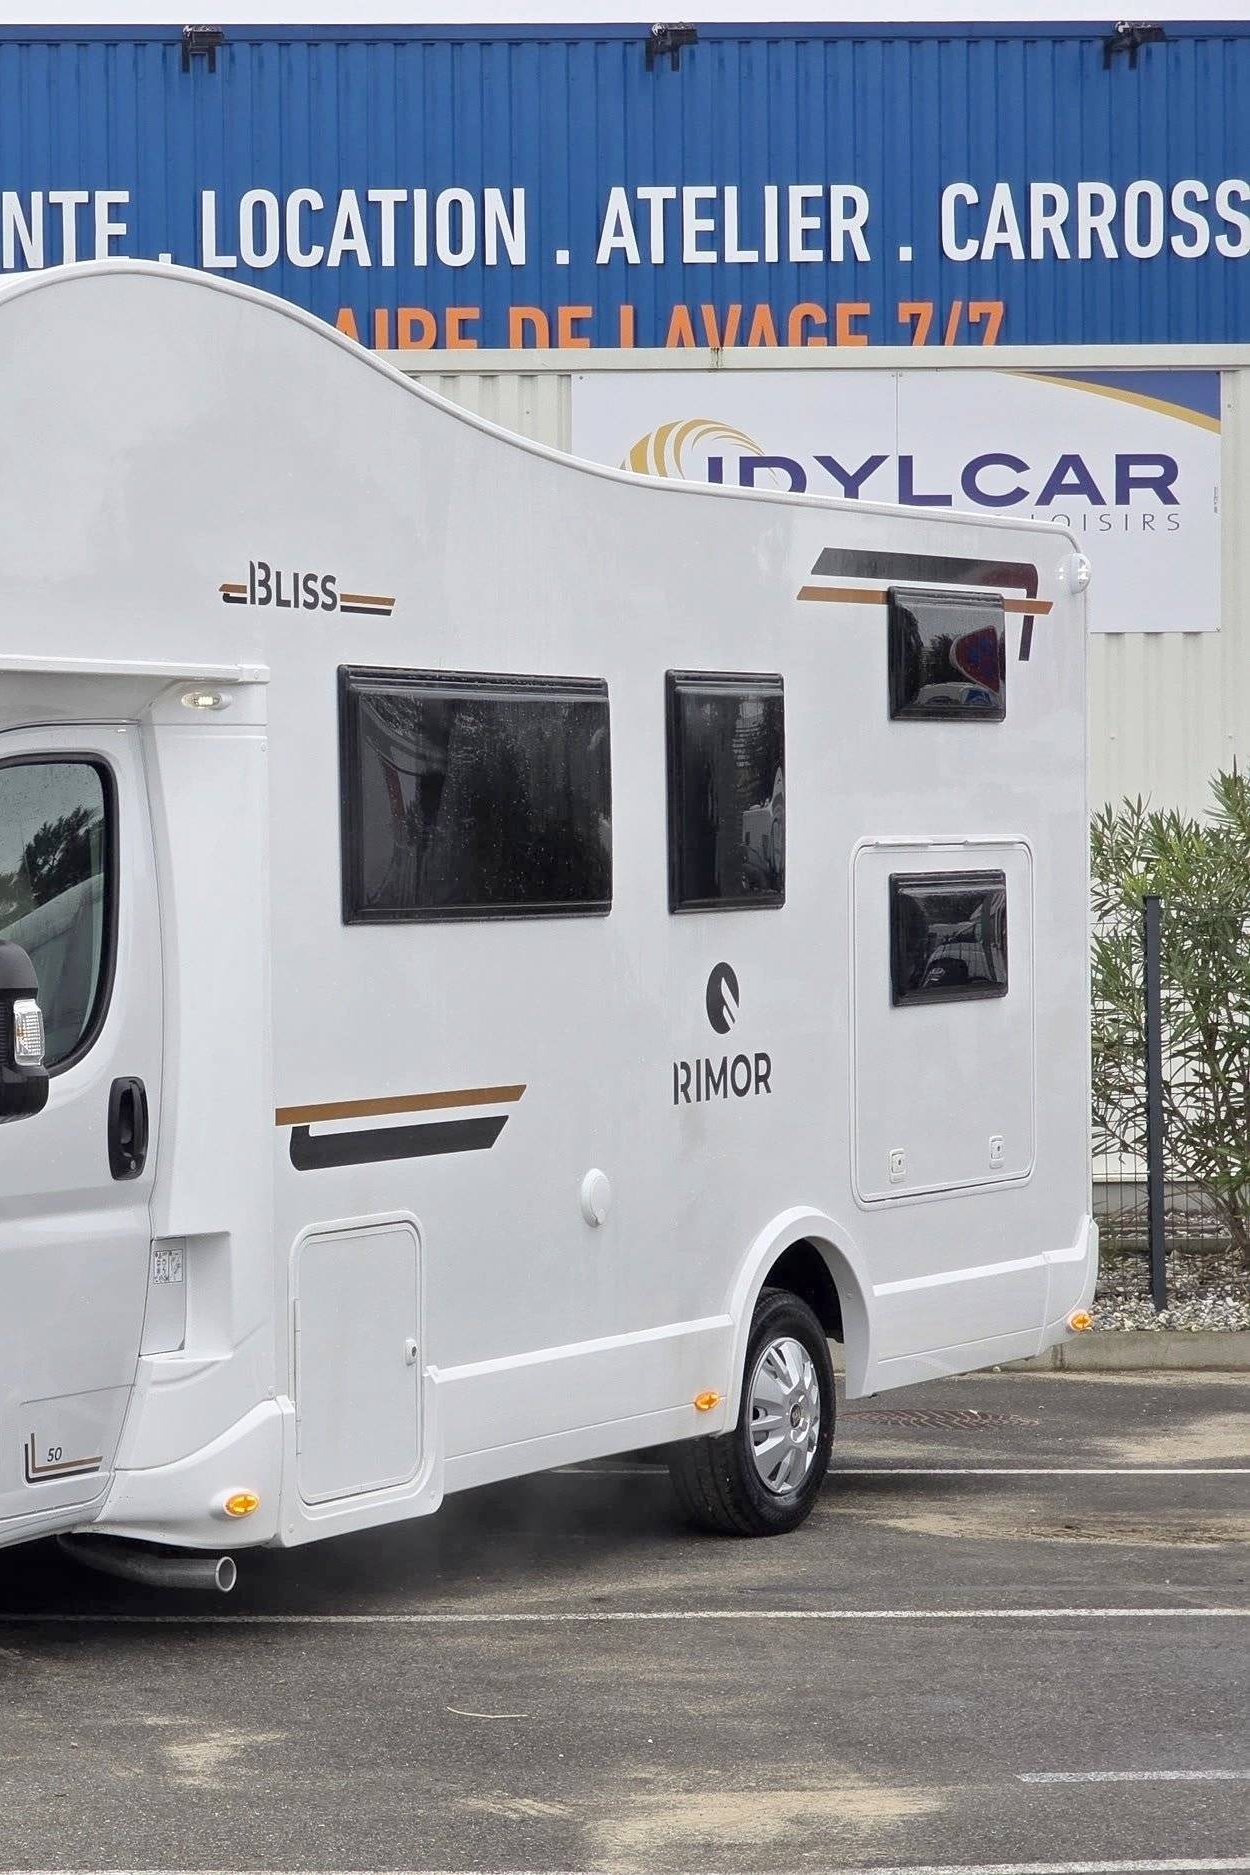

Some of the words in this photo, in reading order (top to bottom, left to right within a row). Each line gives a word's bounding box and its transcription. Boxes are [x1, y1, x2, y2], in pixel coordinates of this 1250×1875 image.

[202, 187, 526, 268] LOCATION
[596, 184, 872, 265] ATELIER
[941, 178, 1250, 262] CARROSS
[509, 305, 593, 349] DE
[898, 300, 1005, 348] 7/7
[707, 453, 1181, 507] IDYLCAR
[249, 560, 338, 612] BLISS
[673, 1052, 772, 1105] RIMOR
[47, 1446, 63, 1462] 50
